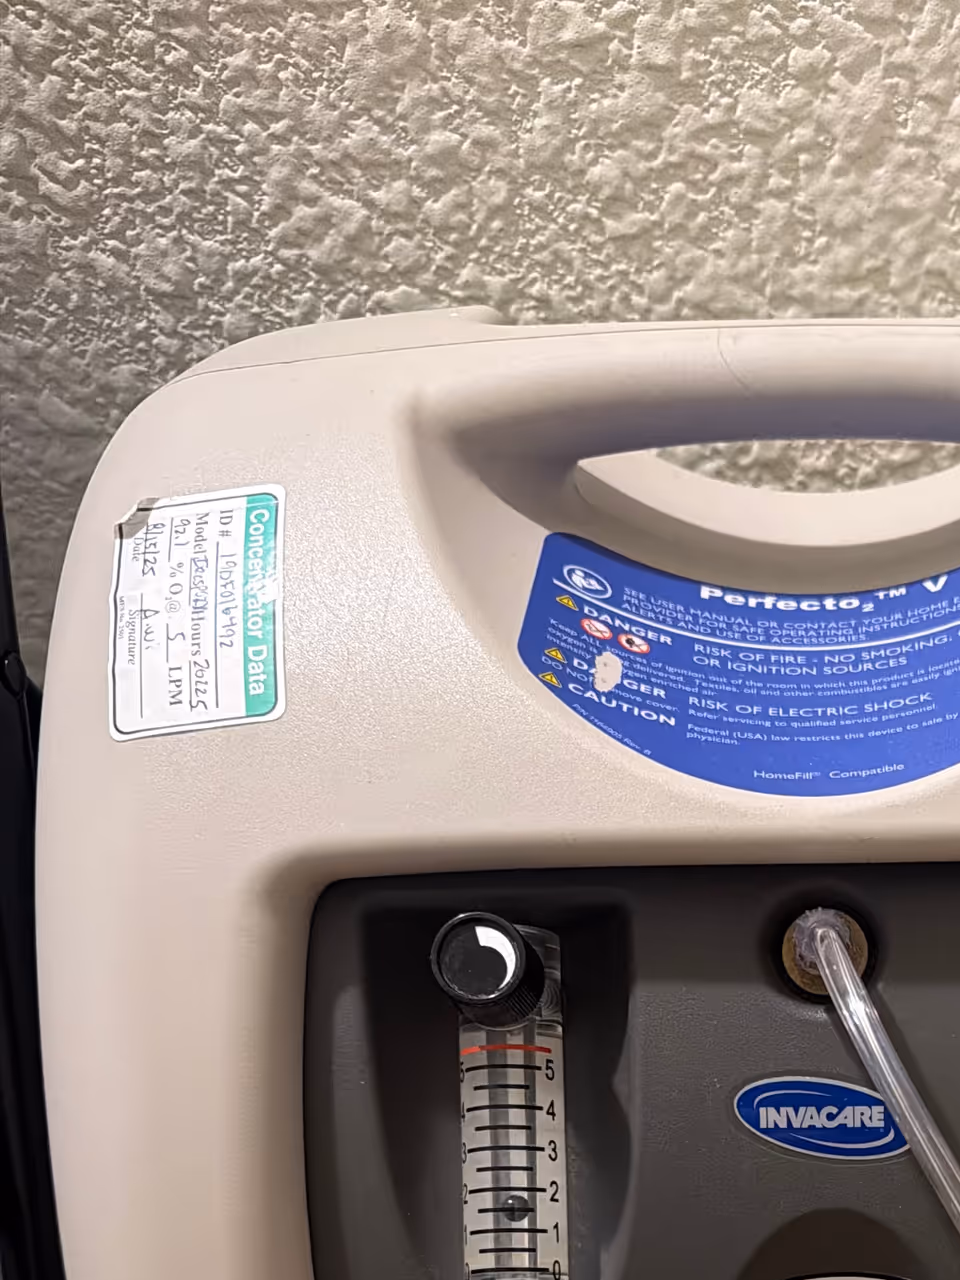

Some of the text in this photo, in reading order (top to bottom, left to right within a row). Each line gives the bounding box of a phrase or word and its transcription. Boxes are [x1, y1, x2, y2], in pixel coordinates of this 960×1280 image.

[193, 512, 210, 557] Model
[218, 509, 233, 538] ID #
[131, 538, 145, 562] Date
[169, 562, 184, 578] %
[921, 575, 948, 592] V
[623, 587, 648, 601] SEE
[651, 595, 686, 613] USER
[690, 607, 753, 626] MANUAL
[757, 620, 778, 629] OR
[783, 620, 857, 630] CONTACT
[862, 612, 904, 626] YOUR
[907, 600, 949, 617] HOME
[623, 594, 694, 623] PROVIDER
[698, 618, 727, 630] FOR
[732, 624, 765, 635] SAFE
[770, 627, 846, 637] OPERATING
[191, 605, 208, 657] Hours
[583, 604, 673, 646] DANGER
[621, 602, 674, 625] ALERTS
[677, 620, 712, 635] AND
[716, 628, 742, 641] USE
[746, 633, 767, 643] OF
[125, 608, 138, 666] Signature
[541, 655, 563, 671] DO
[546, 635, 593, 660] intensity
[650, 677, 699, 694] enriched
[547, 627, 585, 648] oxygen
[588, 645, 599, 655] is
[761, 689, 780, 697] and
[817, 685, 888, 697] combustibles
[891, 679, 909, 687] are
[911, 672, 940, 687] easily
[549, 617, 579, 637] Keep
[580, 633, 602, 649] ALL
[606, 645, 648, 665] sources
[651, 659, 663, 669] of
[665, 665, 706, 681] ignition
[708, 675, 728, 683] out
[814, 681, 846, 689] which
[850, 679, 868, 687] this
[872, 671, 915, 685] product
[693, 656, 908, 676] OR IGNITION SOURCES
[694, 642, 733, 659] RISK
[738, 652, 765, 662] OF
[771, 655, 807, 664] FIRE
[825, 654, 856, 665] NO
[247, 645, 268, 696] Data
[573, 658, 668, 699] DGER
[168, 665, 183, 706] LPM
[567, 682, 676, 726] CAUTION
[688, 692, 934, 718] RISK OF ELECTRIC SHOCK
[687, 723, 730, 737] Federal
[733, 730, 768, 741] (USA)
[794, 734, 841, 742] restricts
[844, 732, 864, 741] this
[868, 725, 903, 738] device
[906, 722, 919, 731] to
[922, 716, 943, 728] sale
[945, 711, 959, 721] by
[688, 708, 720, 721] Refer
[722, 716, 772, 728] servicing
[791, 720, 836, 729] qualified
[839, 715, 878, 727] service
[686, 731, 741, 745] physician.
[829, 763, 905, 779] Compatible
[545, 1060, 555, 1081] 5
[546, 1100, 556, 1121] 4
[758, 1105, 885, 1129] INVACARE
[548, 1140, 558, 1162] 3
[549, 1181, 560, 1202] 2
[552, 1223, 560, 1244] 1
[552, 1260, 561, 1280] 0
